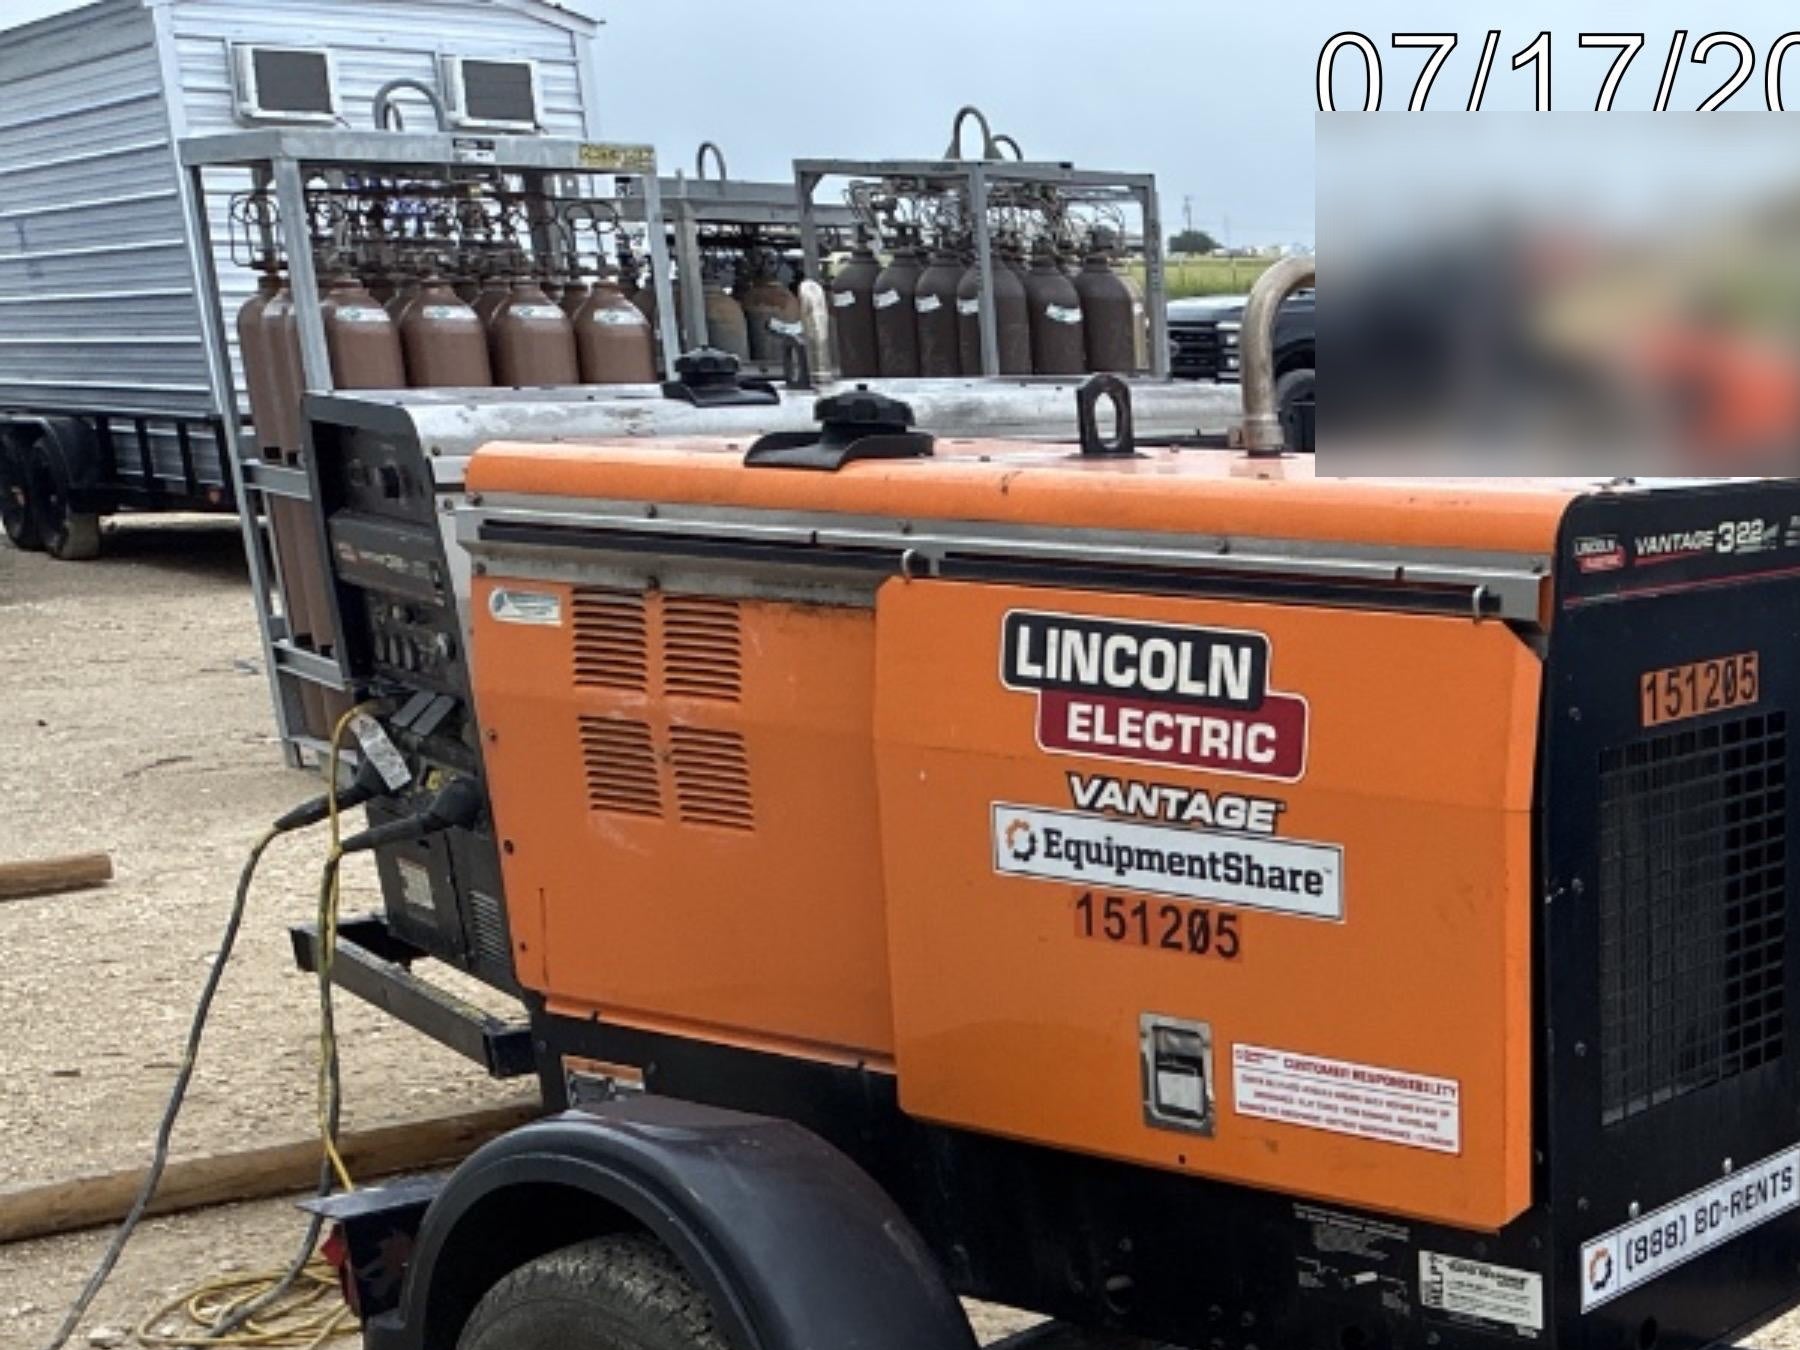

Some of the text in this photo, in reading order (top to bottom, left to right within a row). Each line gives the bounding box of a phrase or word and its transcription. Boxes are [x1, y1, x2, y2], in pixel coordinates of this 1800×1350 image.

[1634, 529, 1714, 557] VANTAGE
[1016, 625, 1252, 700] LINCOLN
[1645, 655, 1756, 721] 151205
[1067, 701, 1277, 763] ELECTRIC
[1068, 774, 1277, 833] VANTAGE
[1043, 828, 1326, 896] EquipmentShare
[1075, 891, 1241, 958] 151205
[1625, 1213, 1687, 1273] (888)
